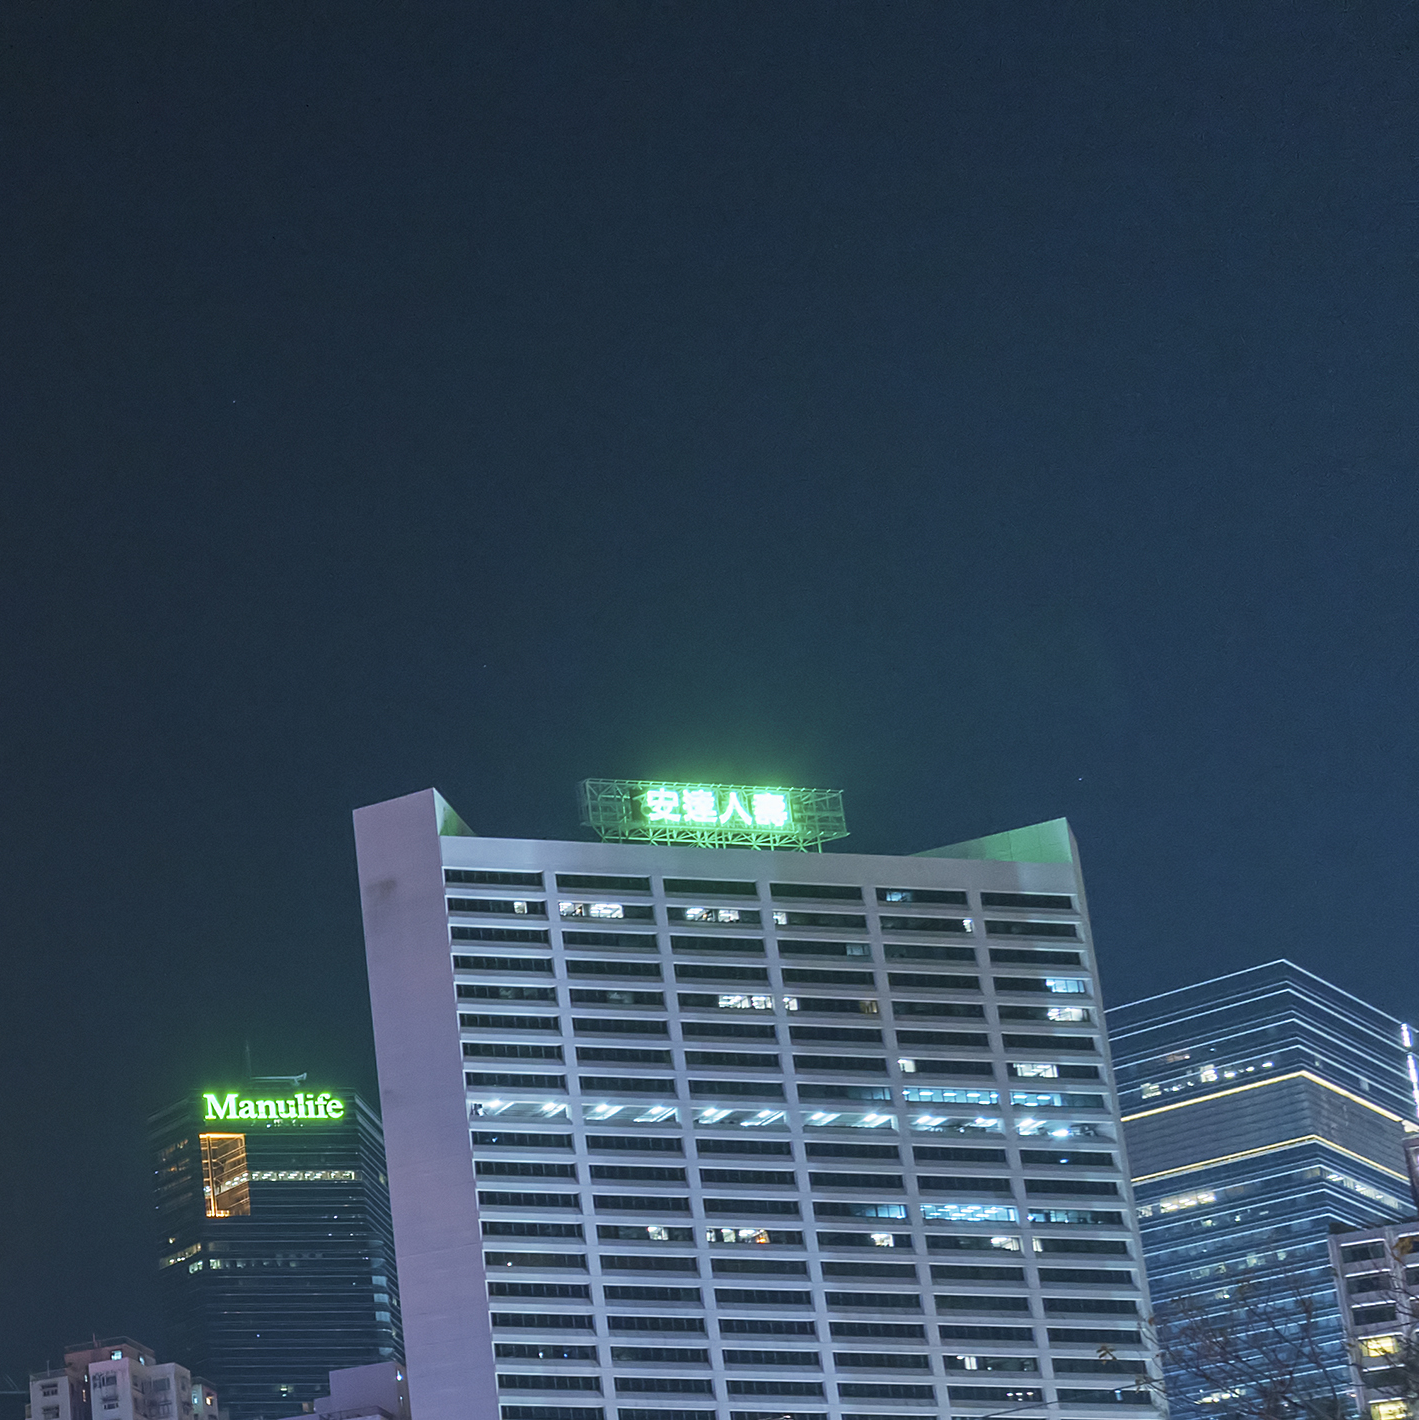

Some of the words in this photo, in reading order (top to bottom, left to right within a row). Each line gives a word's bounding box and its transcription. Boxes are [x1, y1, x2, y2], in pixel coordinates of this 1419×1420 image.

[646, 787, 788, 827] 安達人壽
[202, 1092, 345, 1120] Manulife
